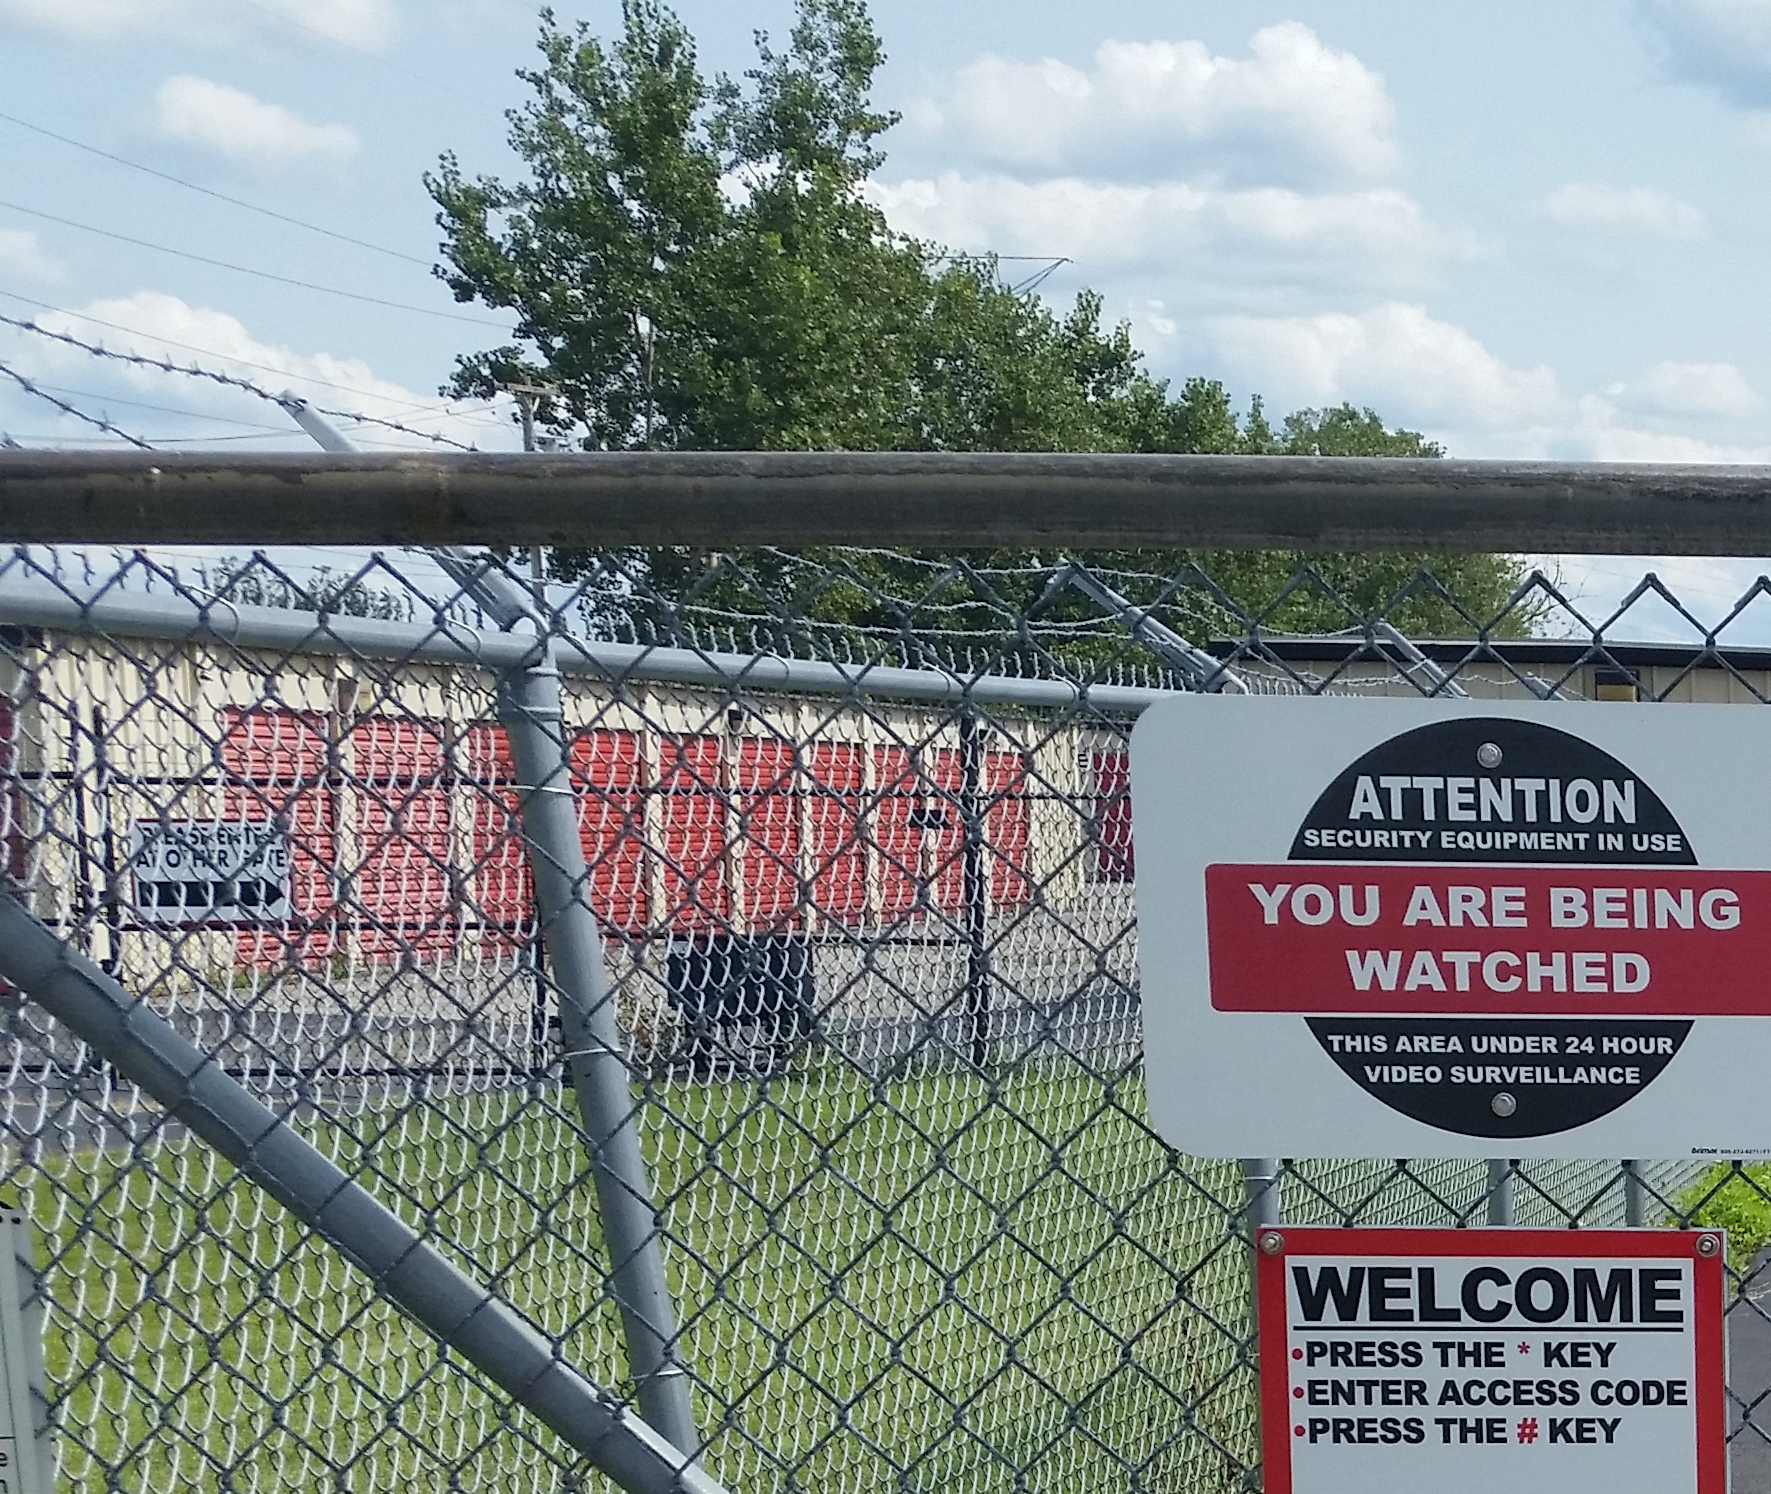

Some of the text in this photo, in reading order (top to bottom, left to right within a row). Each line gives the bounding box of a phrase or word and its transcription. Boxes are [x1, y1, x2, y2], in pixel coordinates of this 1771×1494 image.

[1349, 775, 1637, 824] ATTENTION
[143, 827, 209, 845] PEASE
[1305, 829, 1682, 851] SECURITY EQUIPMENT IN USE
[166, 849, 229, 868] OHR
[1248, 884, 1740, 929] YOU ARE BEING
[1345, 950, 1650, 992] WATCHED
[1329, 1035, 1674, 1053] THIS AREA UNDER 24 HOUR
[1364, 1066, 1640, 1083] VIDEO SURVEILLANCE
[1292, 1266, 1683, 1323] WELCOME
[1307, 1341, 1422, 1367] PRESS
[1433, 1342, 1505, 1367] THE
[1544, 1342, 1617, 1367] KEY
[1308, 1380, 1687, 1405] ENTER ACCESS CODE
[1309, 1418, 1621, 1444] PRESS THE # KEY
